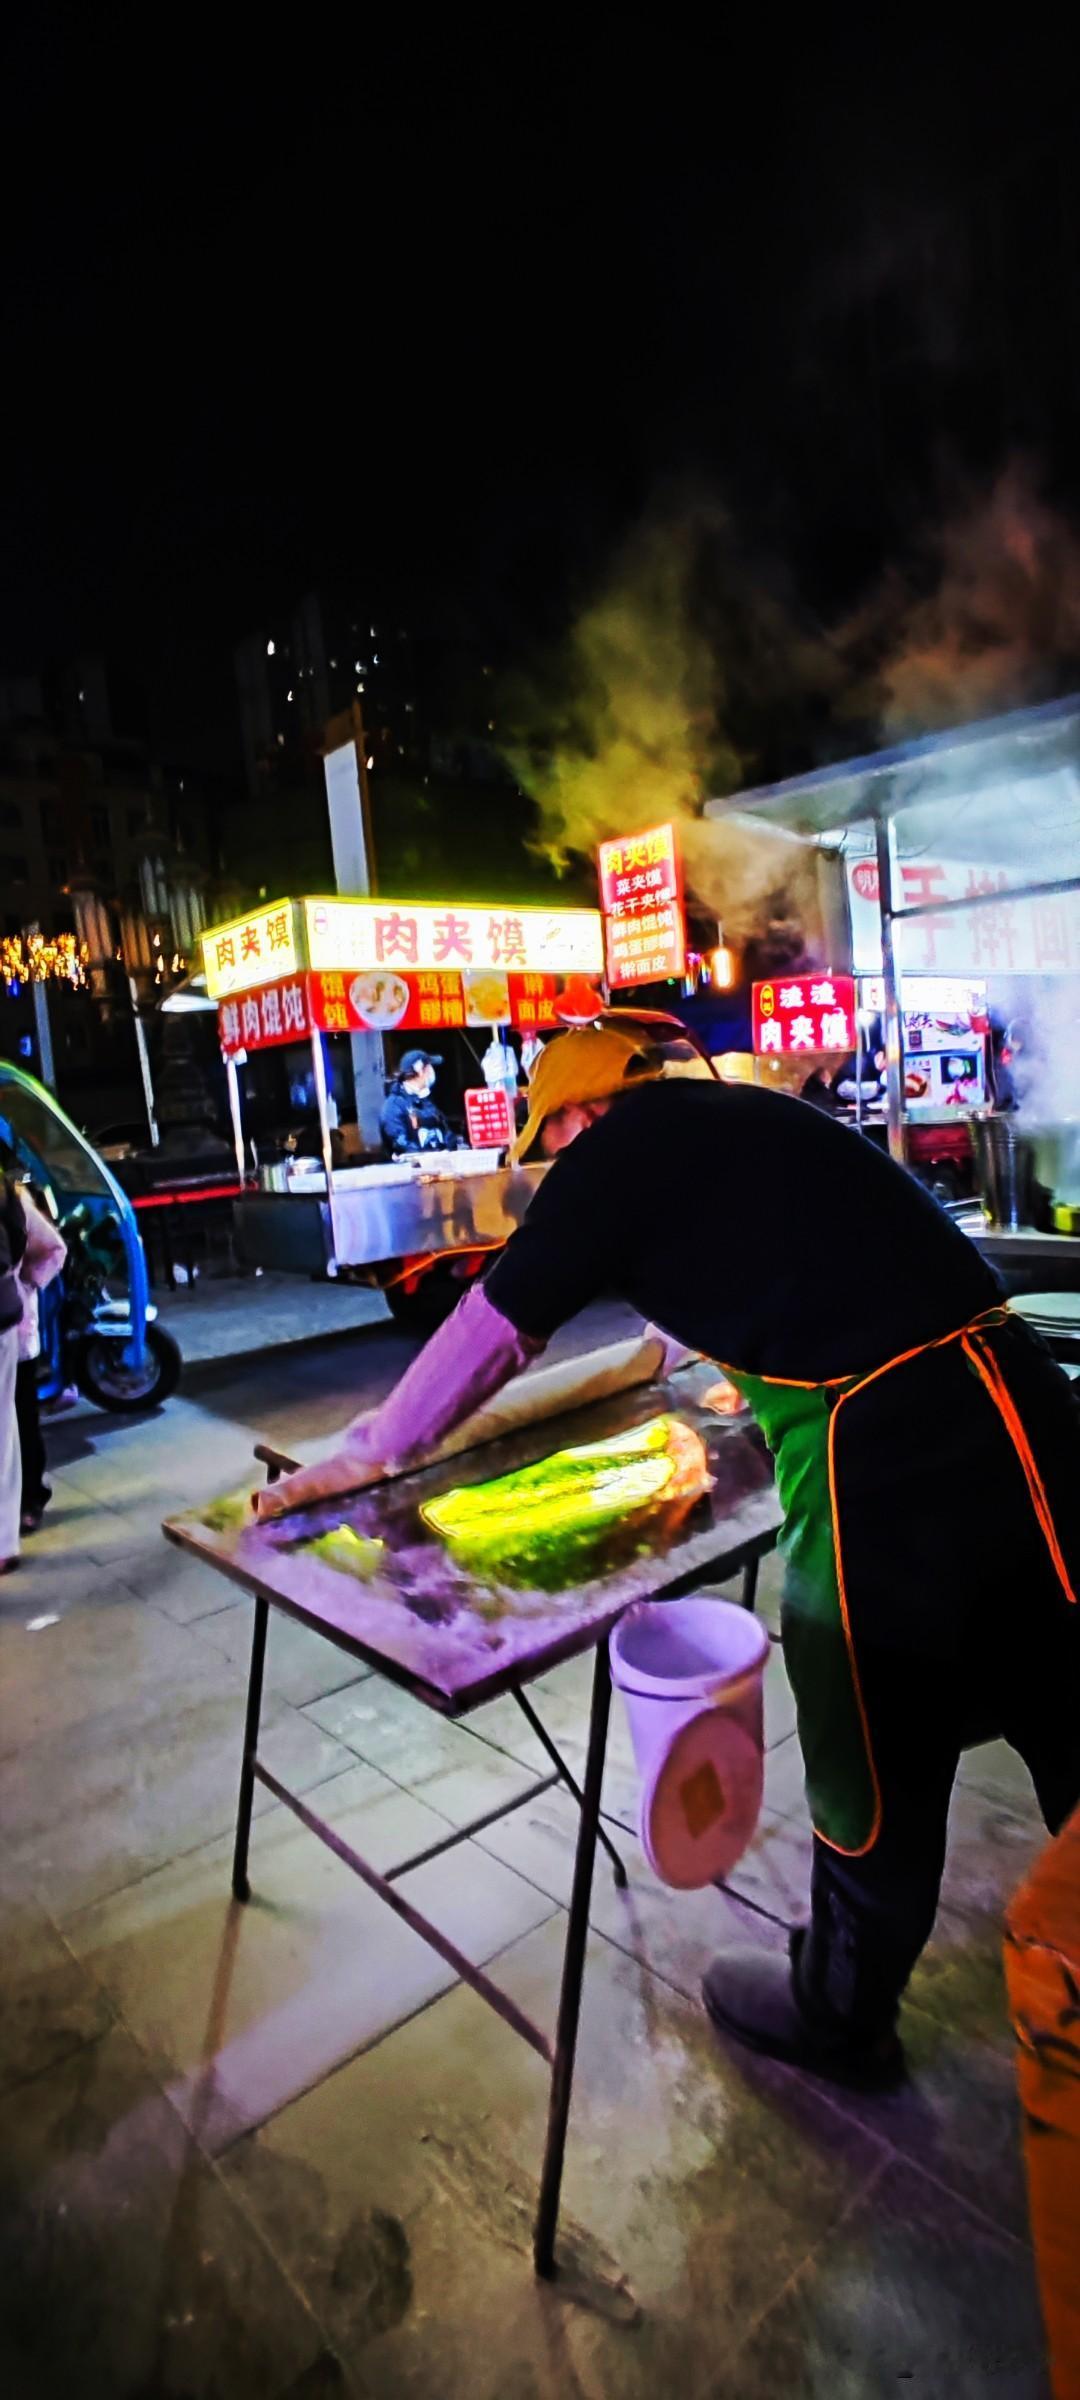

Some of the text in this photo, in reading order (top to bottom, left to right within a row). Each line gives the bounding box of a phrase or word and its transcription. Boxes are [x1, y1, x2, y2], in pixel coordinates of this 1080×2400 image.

[604, 832, 672, 875] 肉夹馍
[616, 868, 663, 896] 菜夹馍
[215, 911, 290, 972] 肉夹馍
[374, 911, 528, 965] 肉夹馍
[222, 979, 306, 1046] 鲜肉馄饨
[760, 1010, 850, 1054] 肉夹馍
